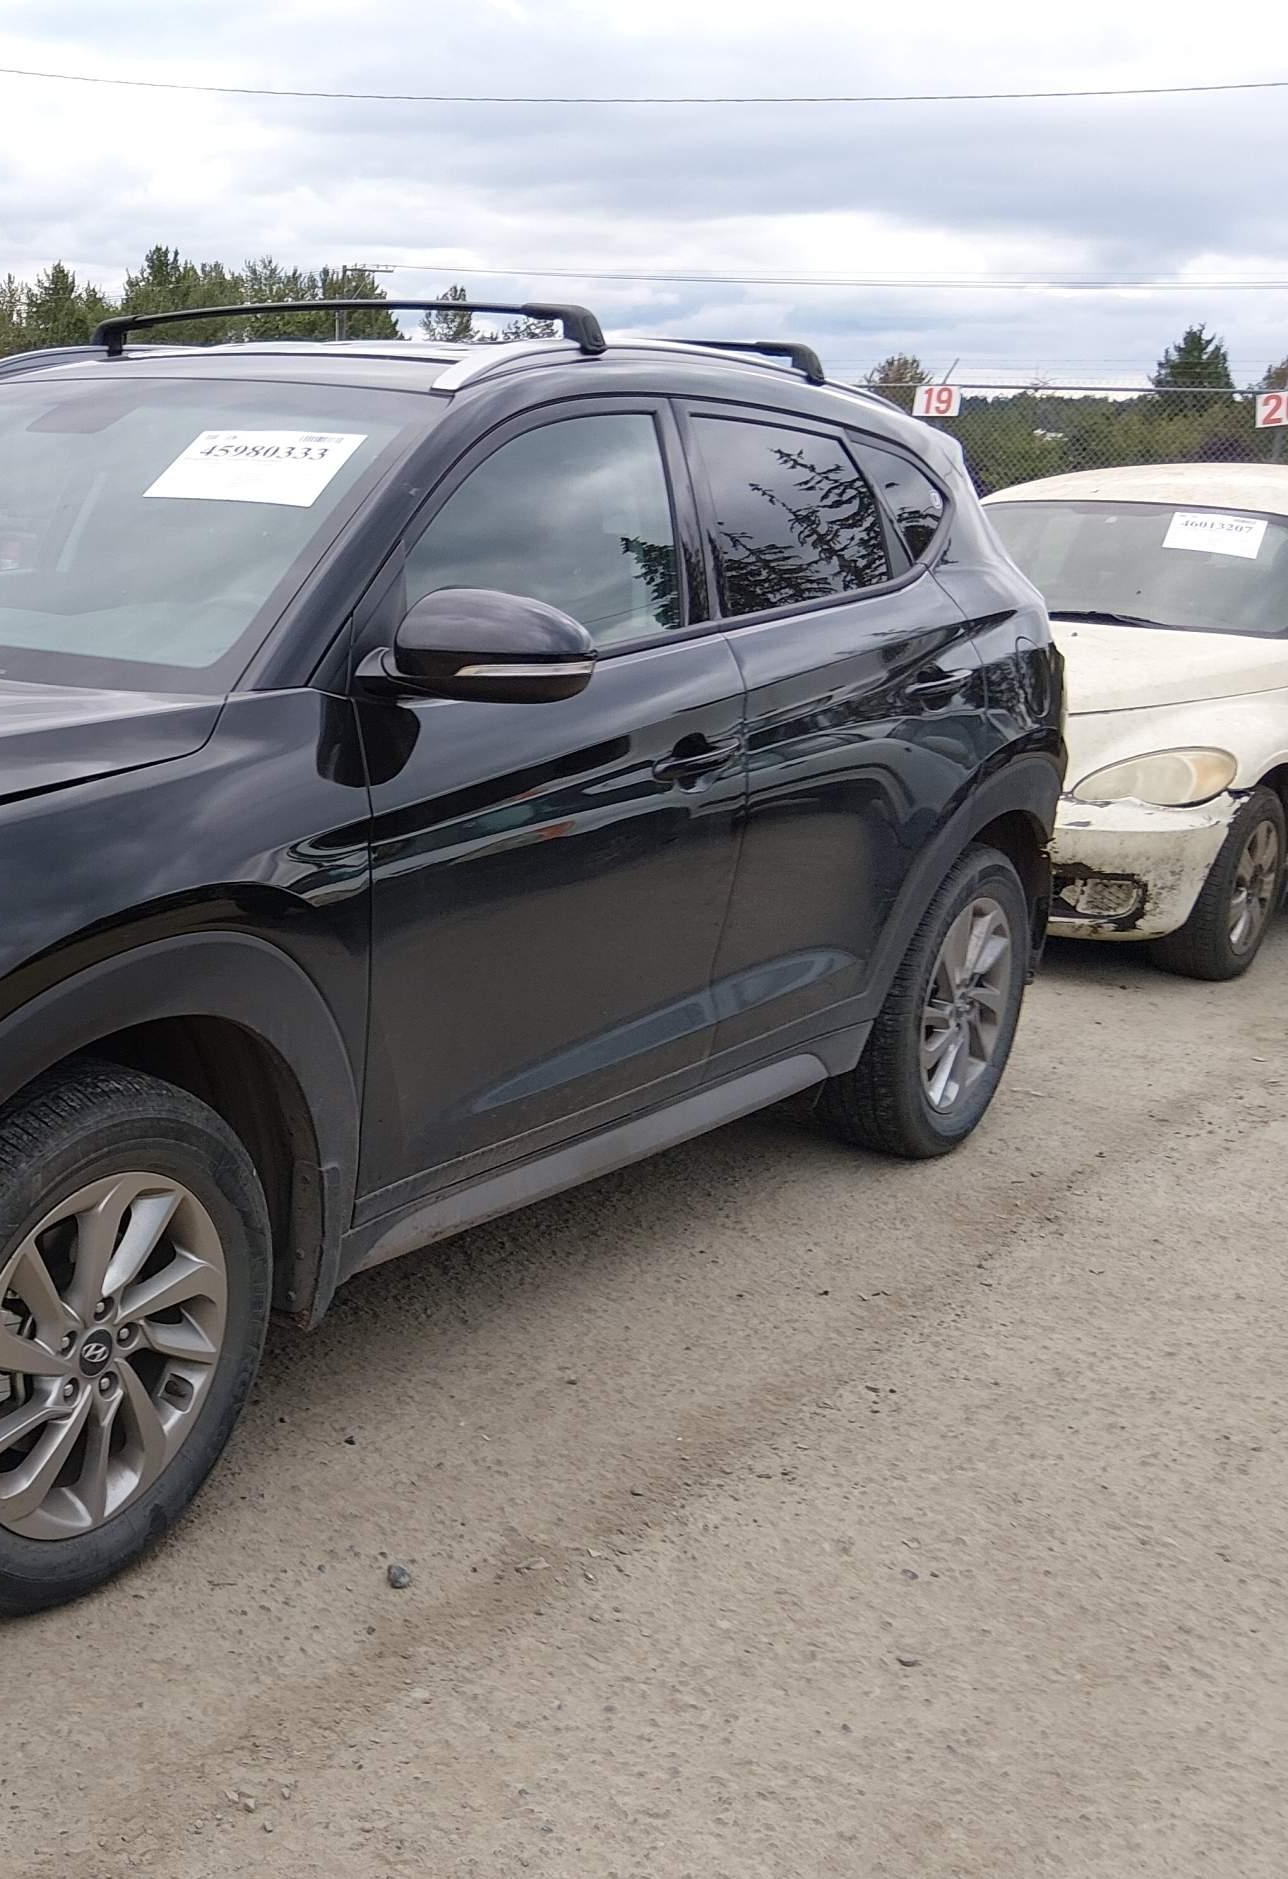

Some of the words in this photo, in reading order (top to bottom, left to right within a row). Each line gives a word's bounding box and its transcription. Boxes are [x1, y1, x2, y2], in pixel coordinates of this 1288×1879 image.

[924, 387, 953, 414] 19
[1262, 394, 1288, 425] 2
[200, 444, 329, 461] 45980333
[1180, 519, 1255, 534] 46013207
